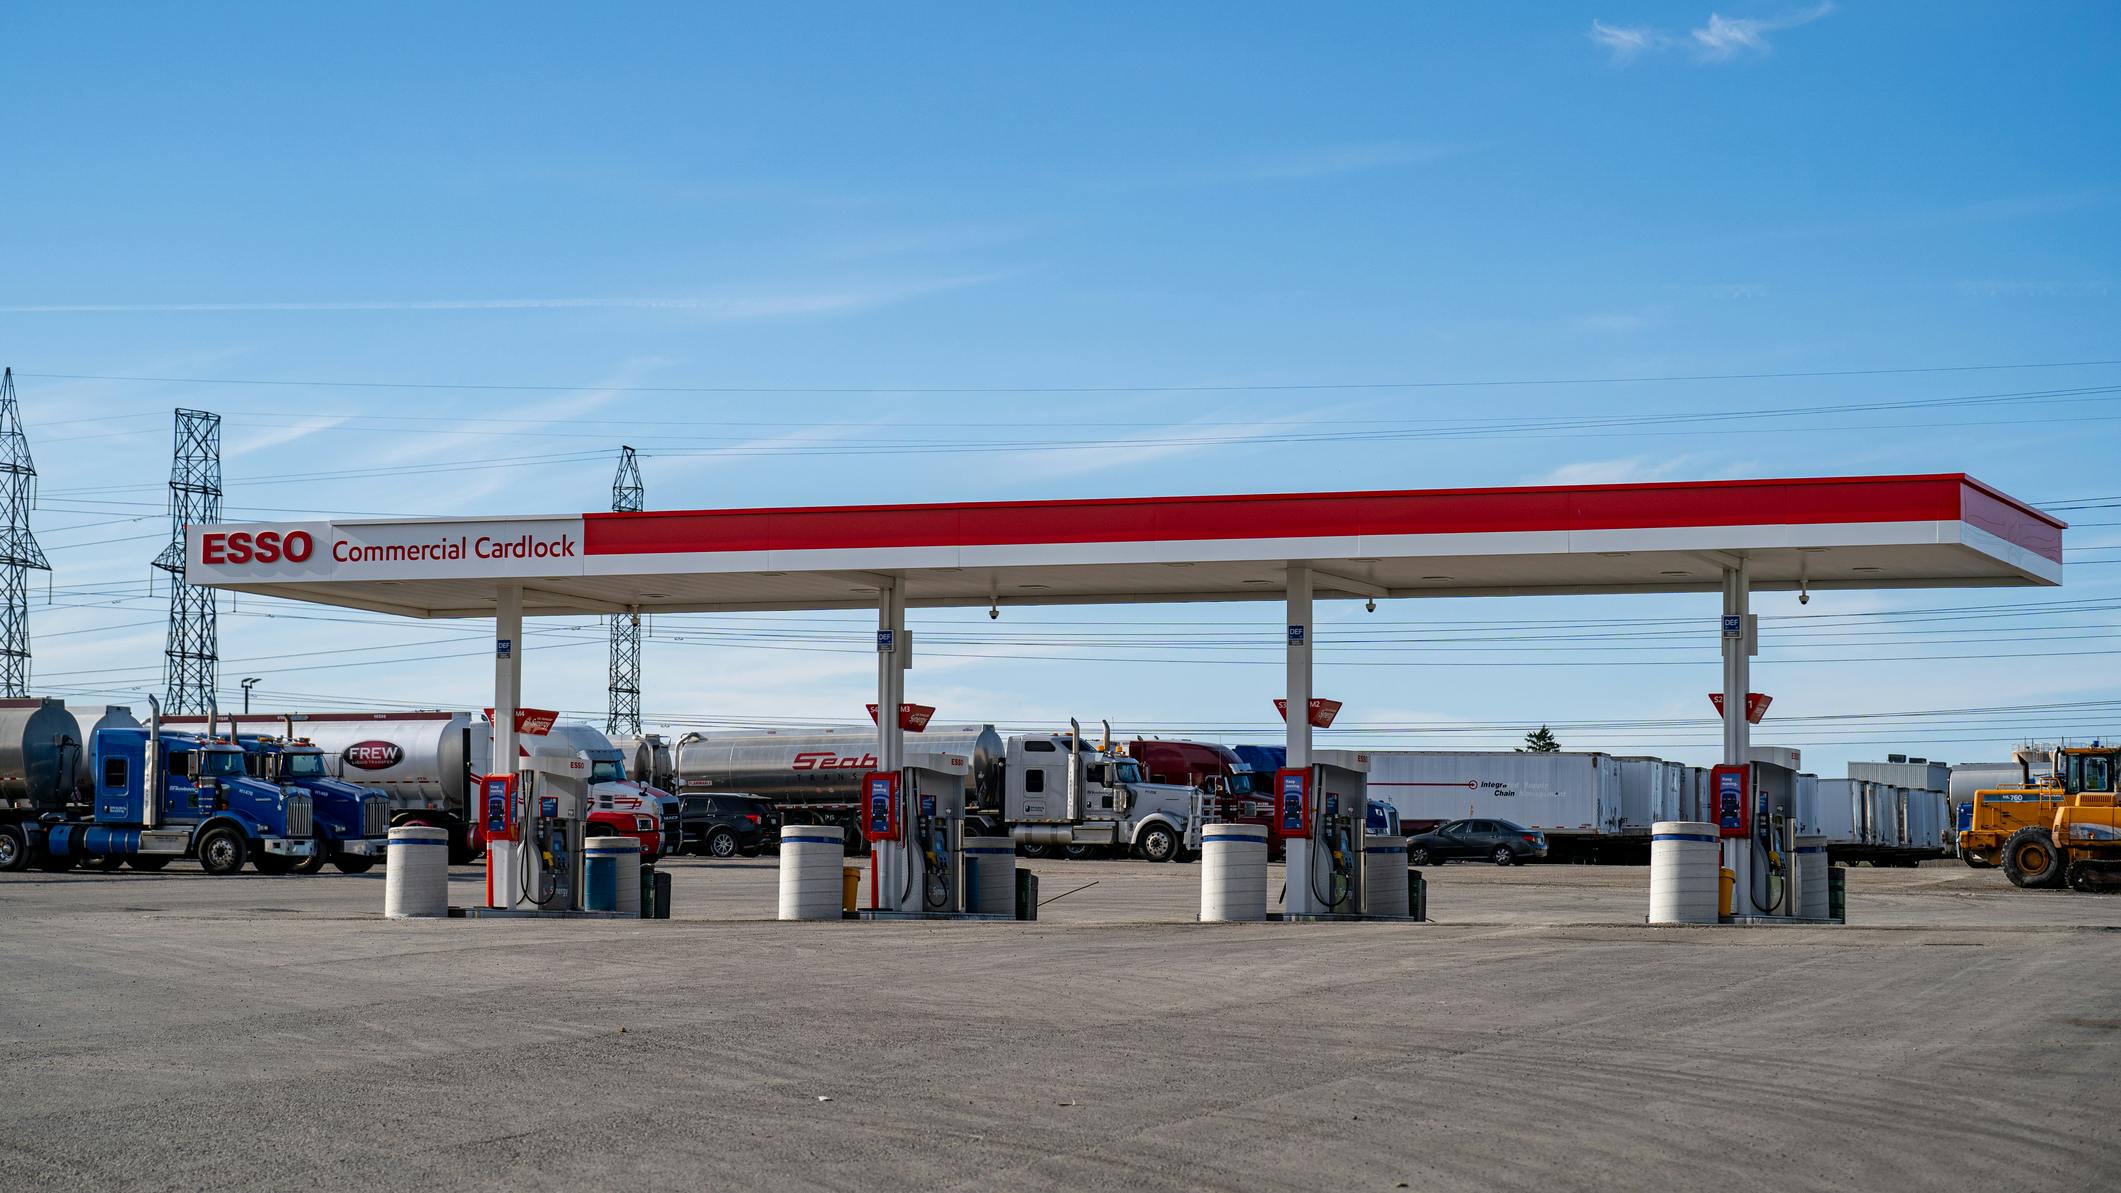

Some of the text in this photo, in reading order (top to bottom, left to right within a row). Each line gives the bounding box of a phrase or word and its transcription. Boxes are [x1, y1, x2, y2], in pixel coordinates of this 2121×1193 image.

[202, 531, 314, 565] ESSO
[332, 534, 575, 562] Commercial Cardlock
[349, 747, 399, 760] FREW
[570, 761, 584, 769] ESSO
[1494, 789, 1515, 797] Chain
